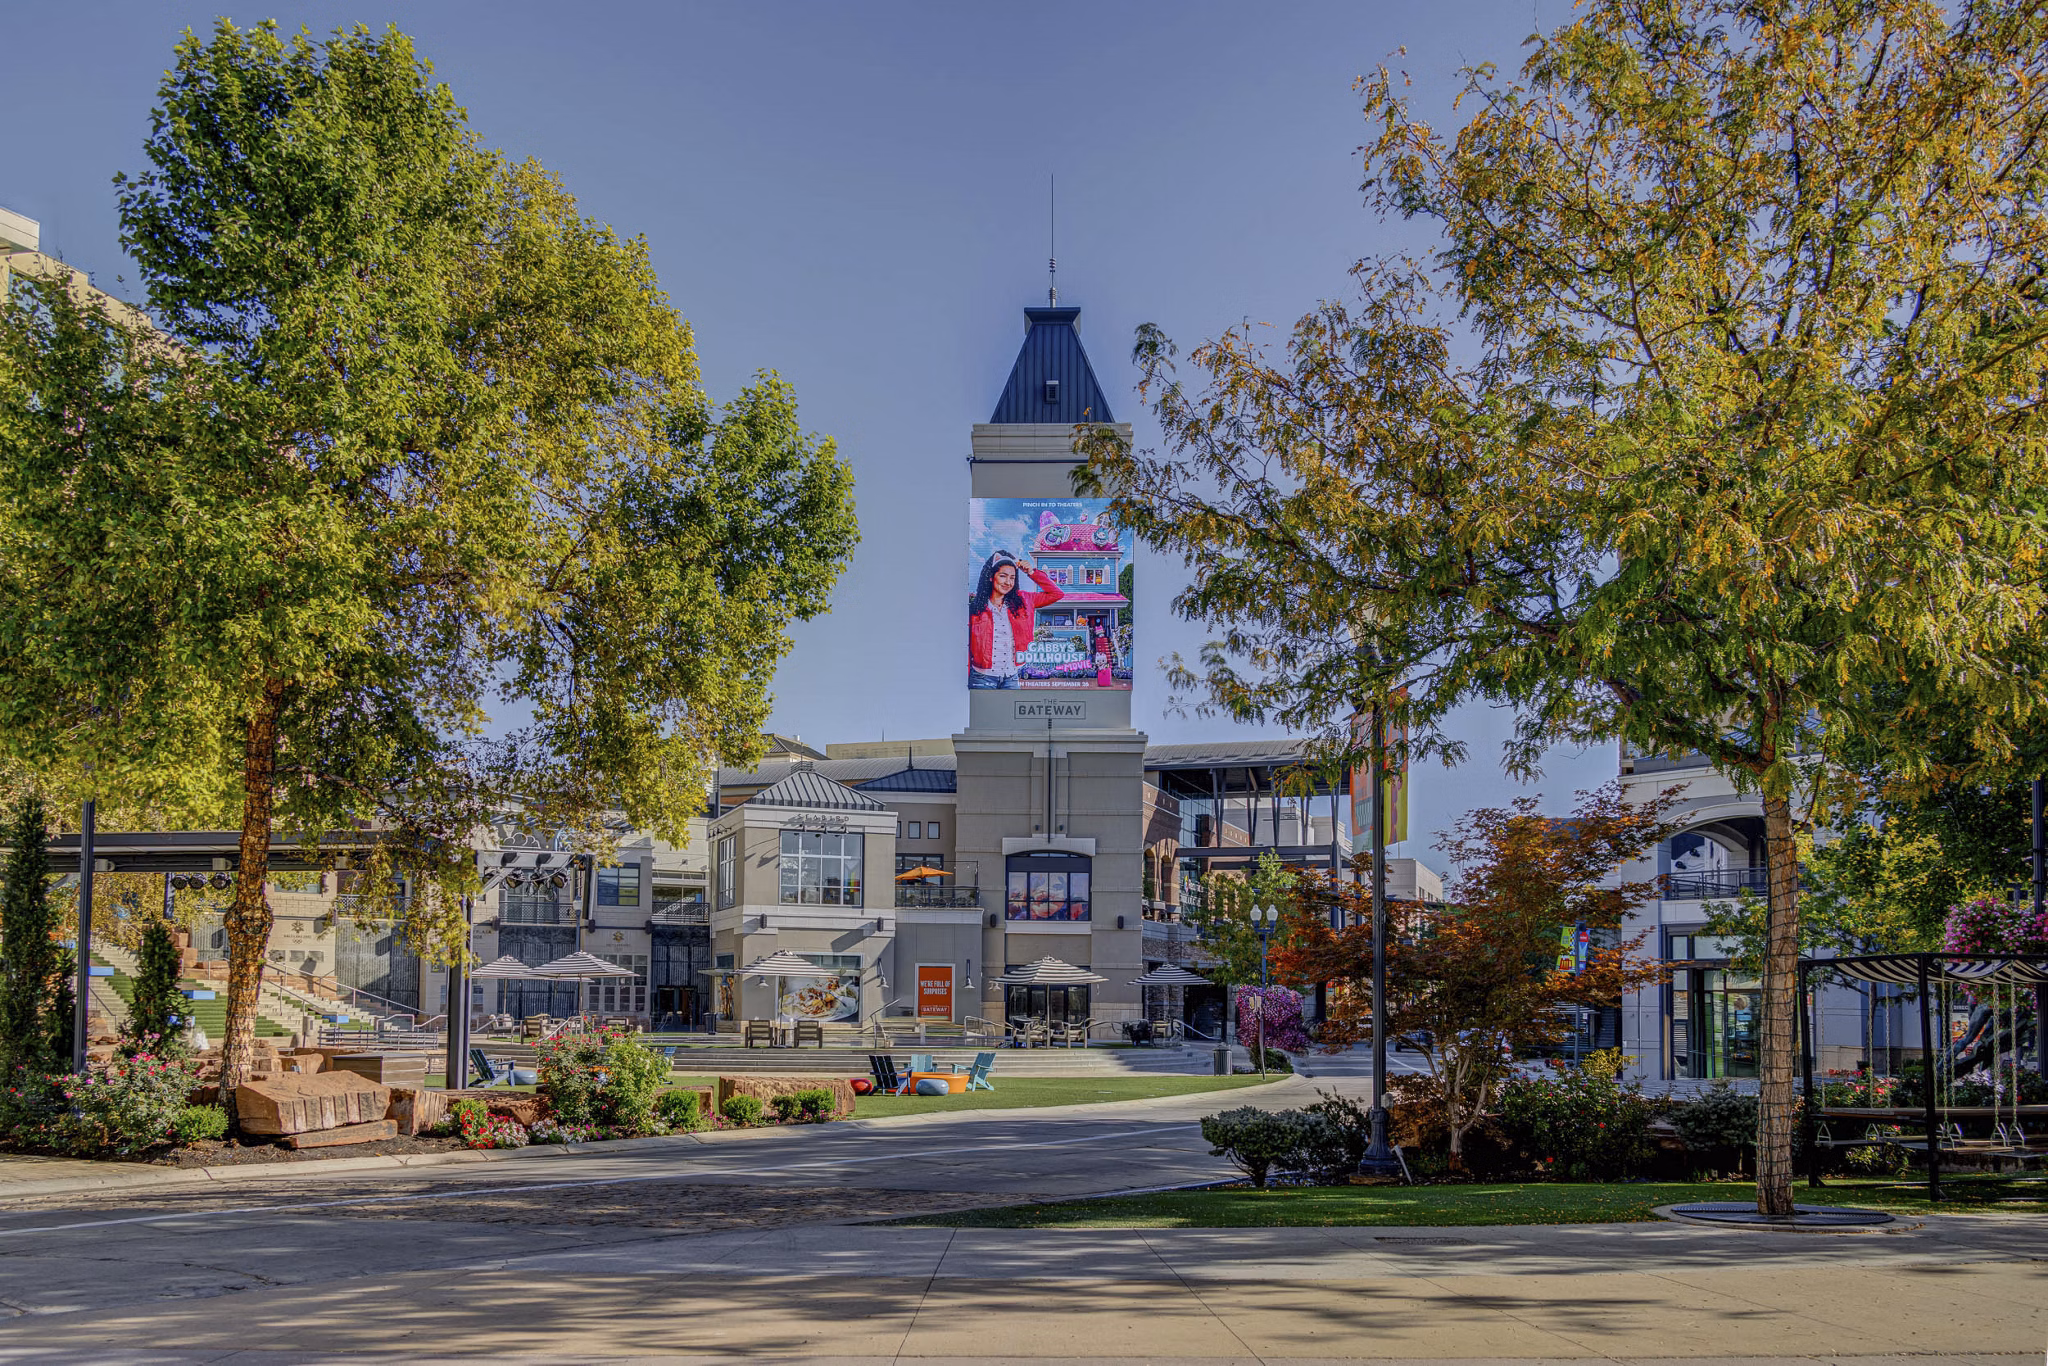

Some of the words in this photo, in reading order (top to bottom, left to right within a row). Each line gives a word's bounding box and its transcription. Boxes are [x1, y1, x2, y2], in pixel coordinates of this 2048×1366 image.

[1028, 642, 1075, 652] GABBY'S
[1016, 652, 1086, 663] DOLLHOUSE
[1064, 660, 1092, 672] MOVIE
[1018, 705, 1081, 715] GATEWAY
[923, 987, 947, 995] SURPRISES
